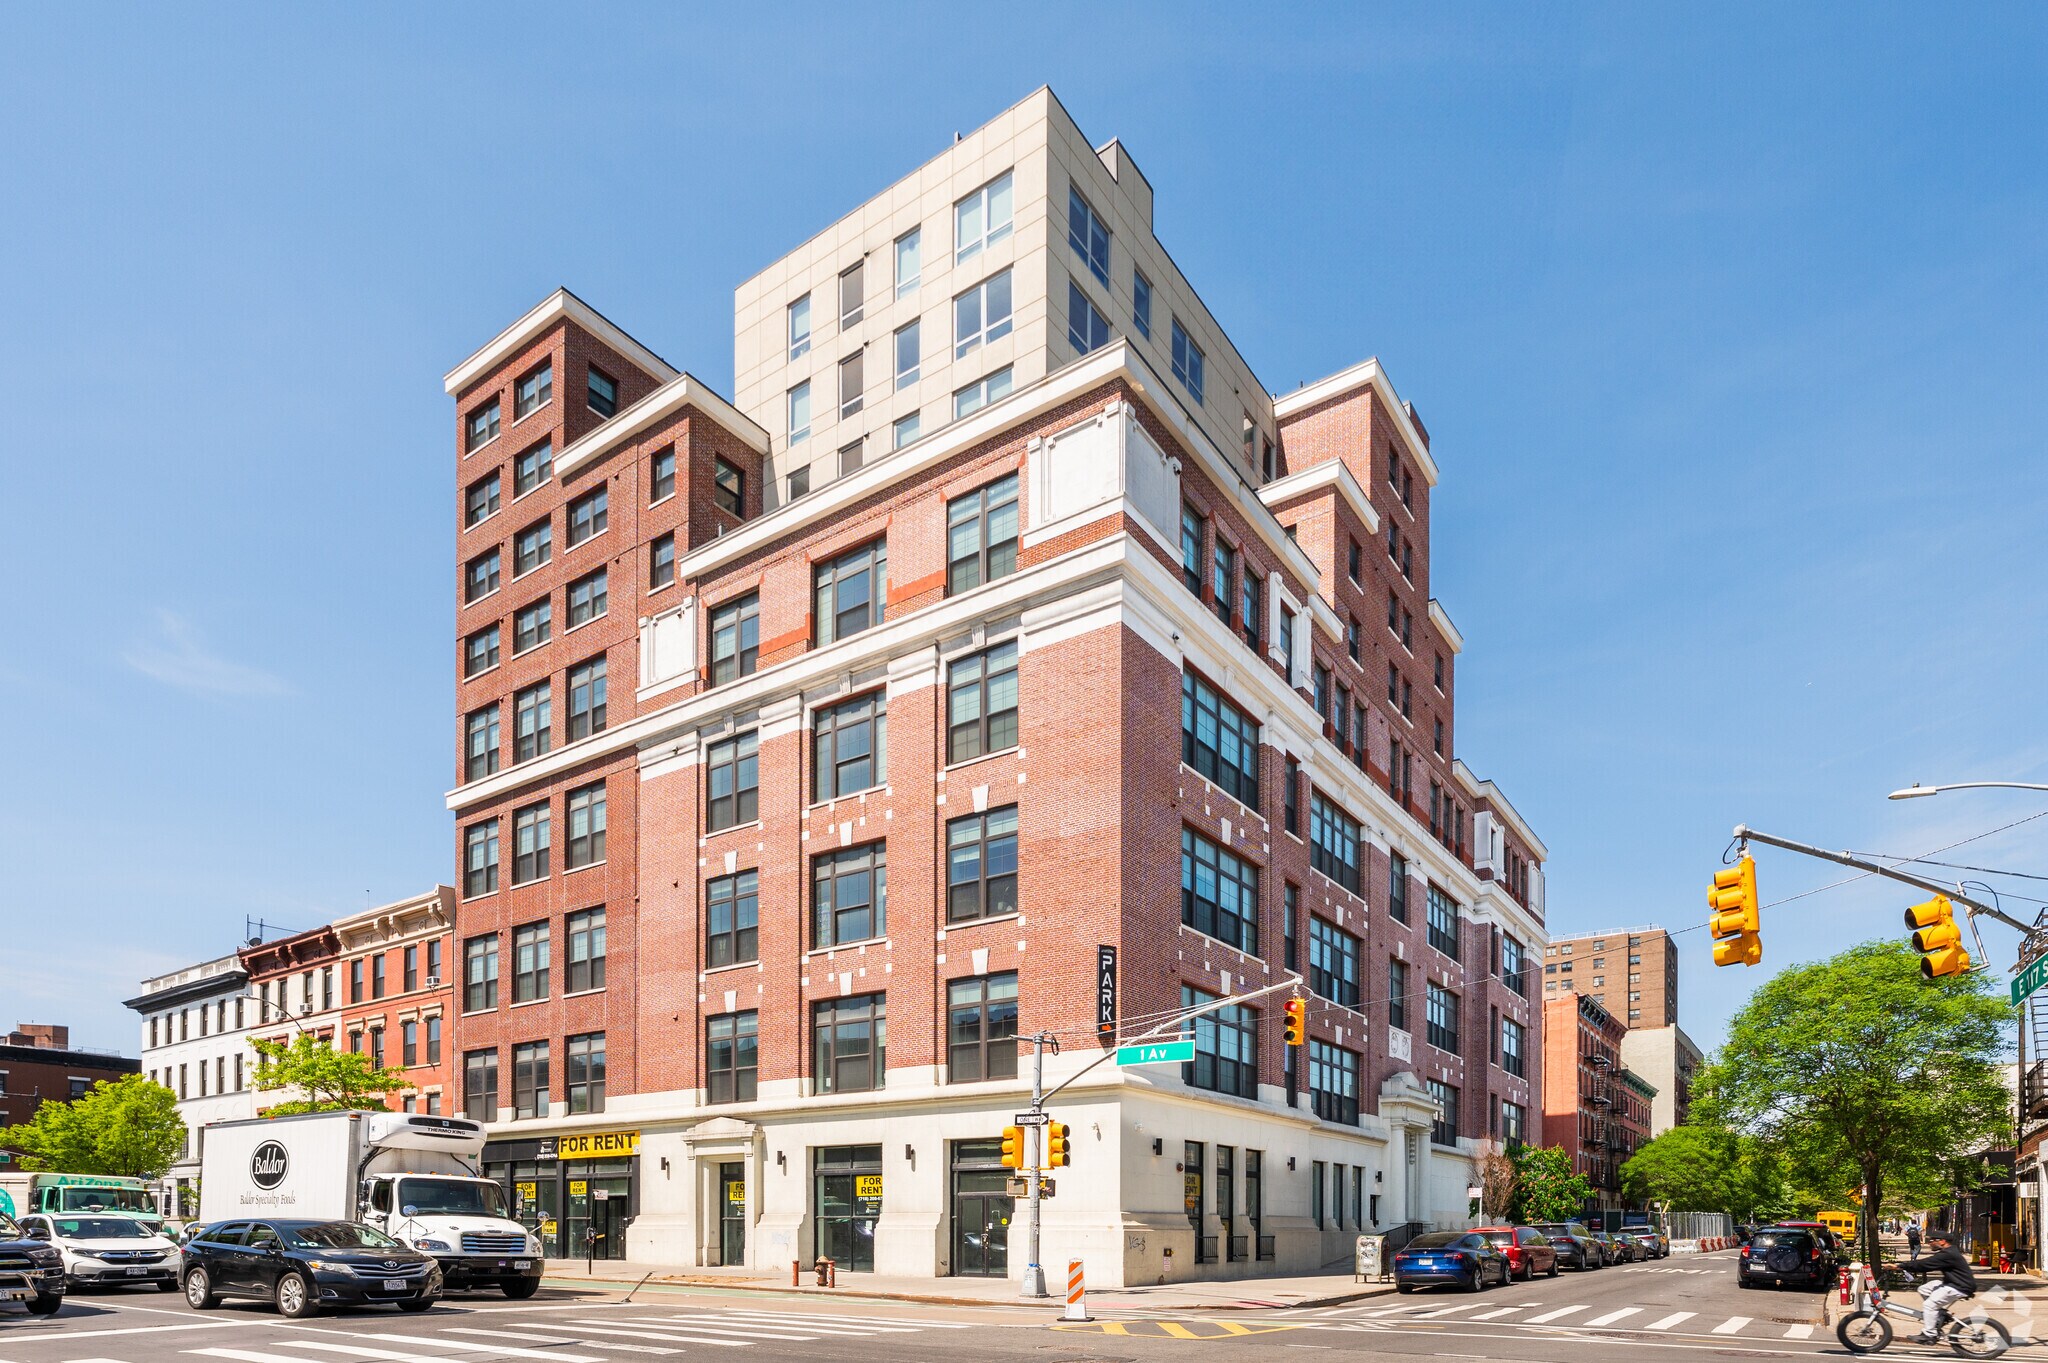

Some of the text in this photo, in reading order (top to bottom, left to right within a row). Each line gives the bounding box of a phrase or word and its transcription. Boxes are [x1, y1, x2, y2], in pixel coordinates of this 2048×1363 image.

[2018, 960, 2048, 996] E 117 S
[1101, 955, 1113, 1021] PARK
[1140, 1047, 1167, 1061] 1 Av
[560, 1136, 589, 1153] FOR
[594, 1132, 636, 1150] RENT
[254, 1147, 285, 1175] Baldor
[735, 1183, 745, 1191] FO
[863, 1177, 882, 1185] FOR
[733, 1191, 745, 1199] RE
[861, 1186, 883, 1194] RENT
[1185, 1185, 1198, 1194] ENT
[240, 1190, 296, 1208] Baldor Specialty Foods
